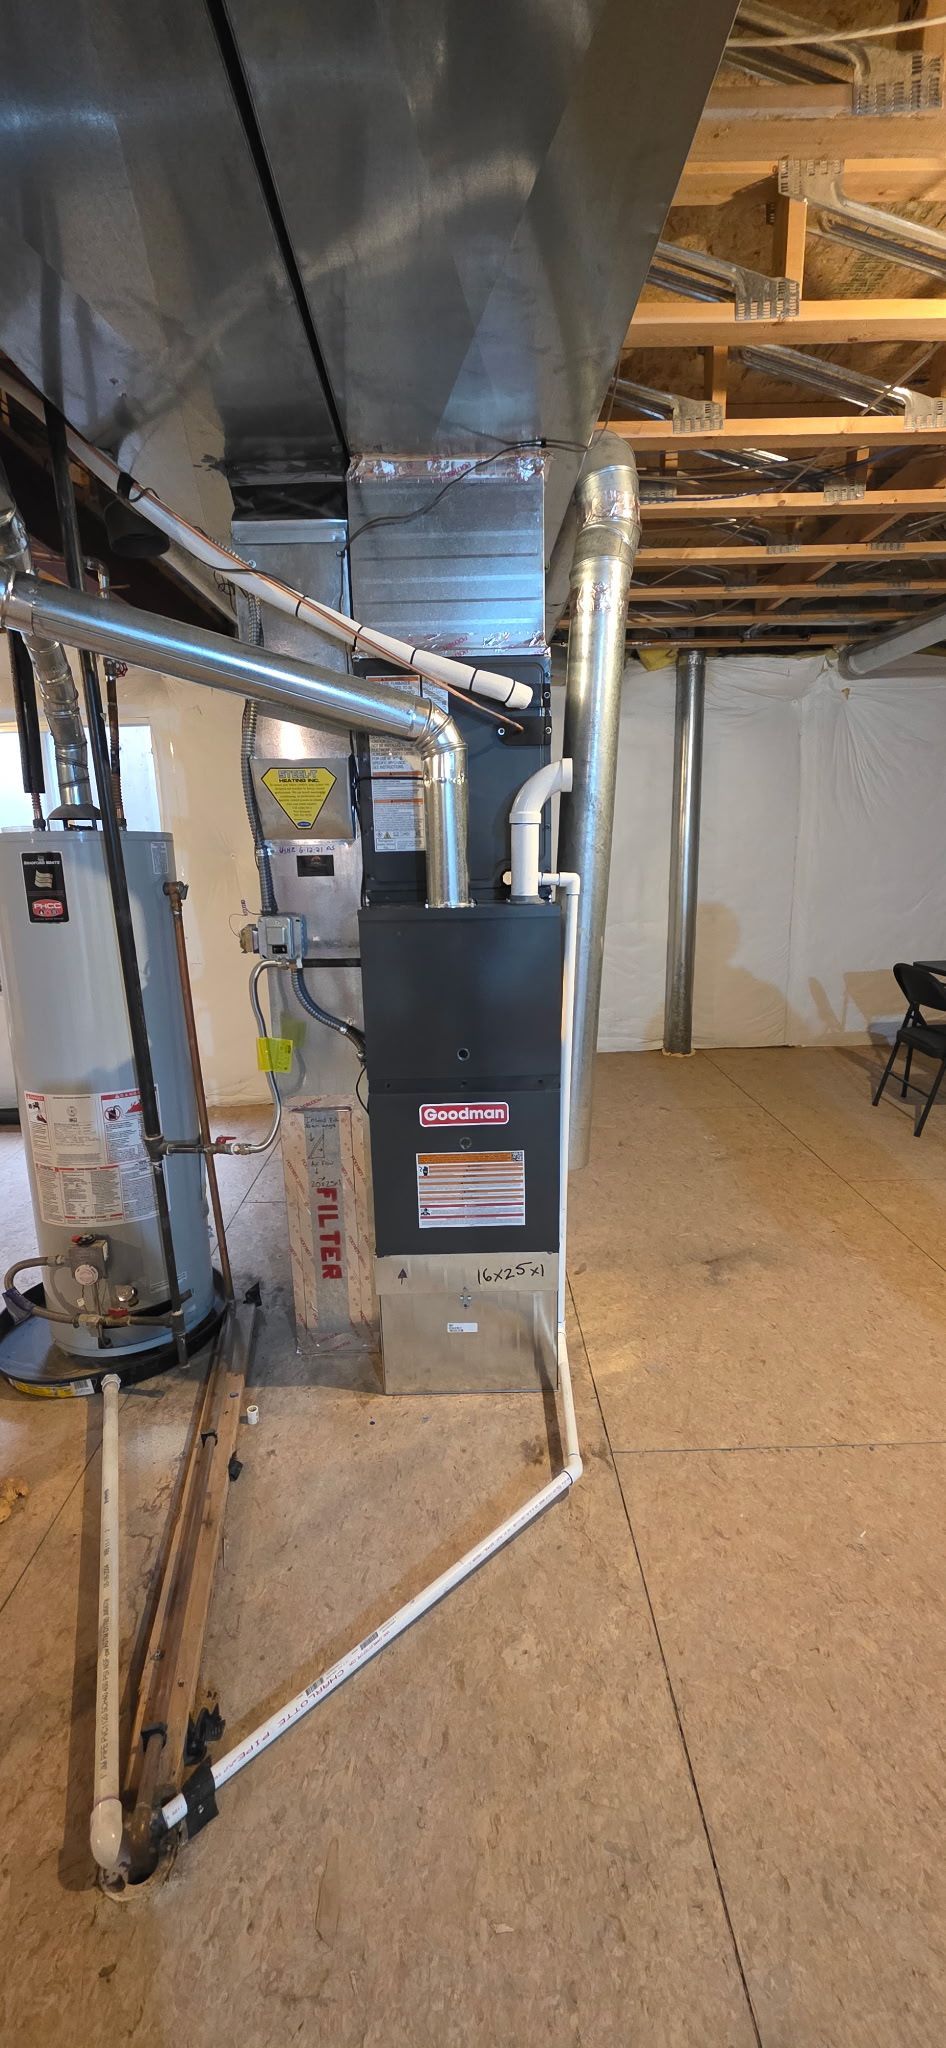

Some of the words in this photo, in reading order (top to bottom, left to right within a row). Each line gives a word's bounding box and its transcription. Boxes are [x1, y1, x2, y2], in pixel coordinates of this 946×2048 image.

[424, 1107, 504, 1121] Goodman
[316, 1188, 342, 1278] FILTER
[278, 1669, 344, 1724] CHARLOTTE
[237, 1731, 270, 1760] PIPE
